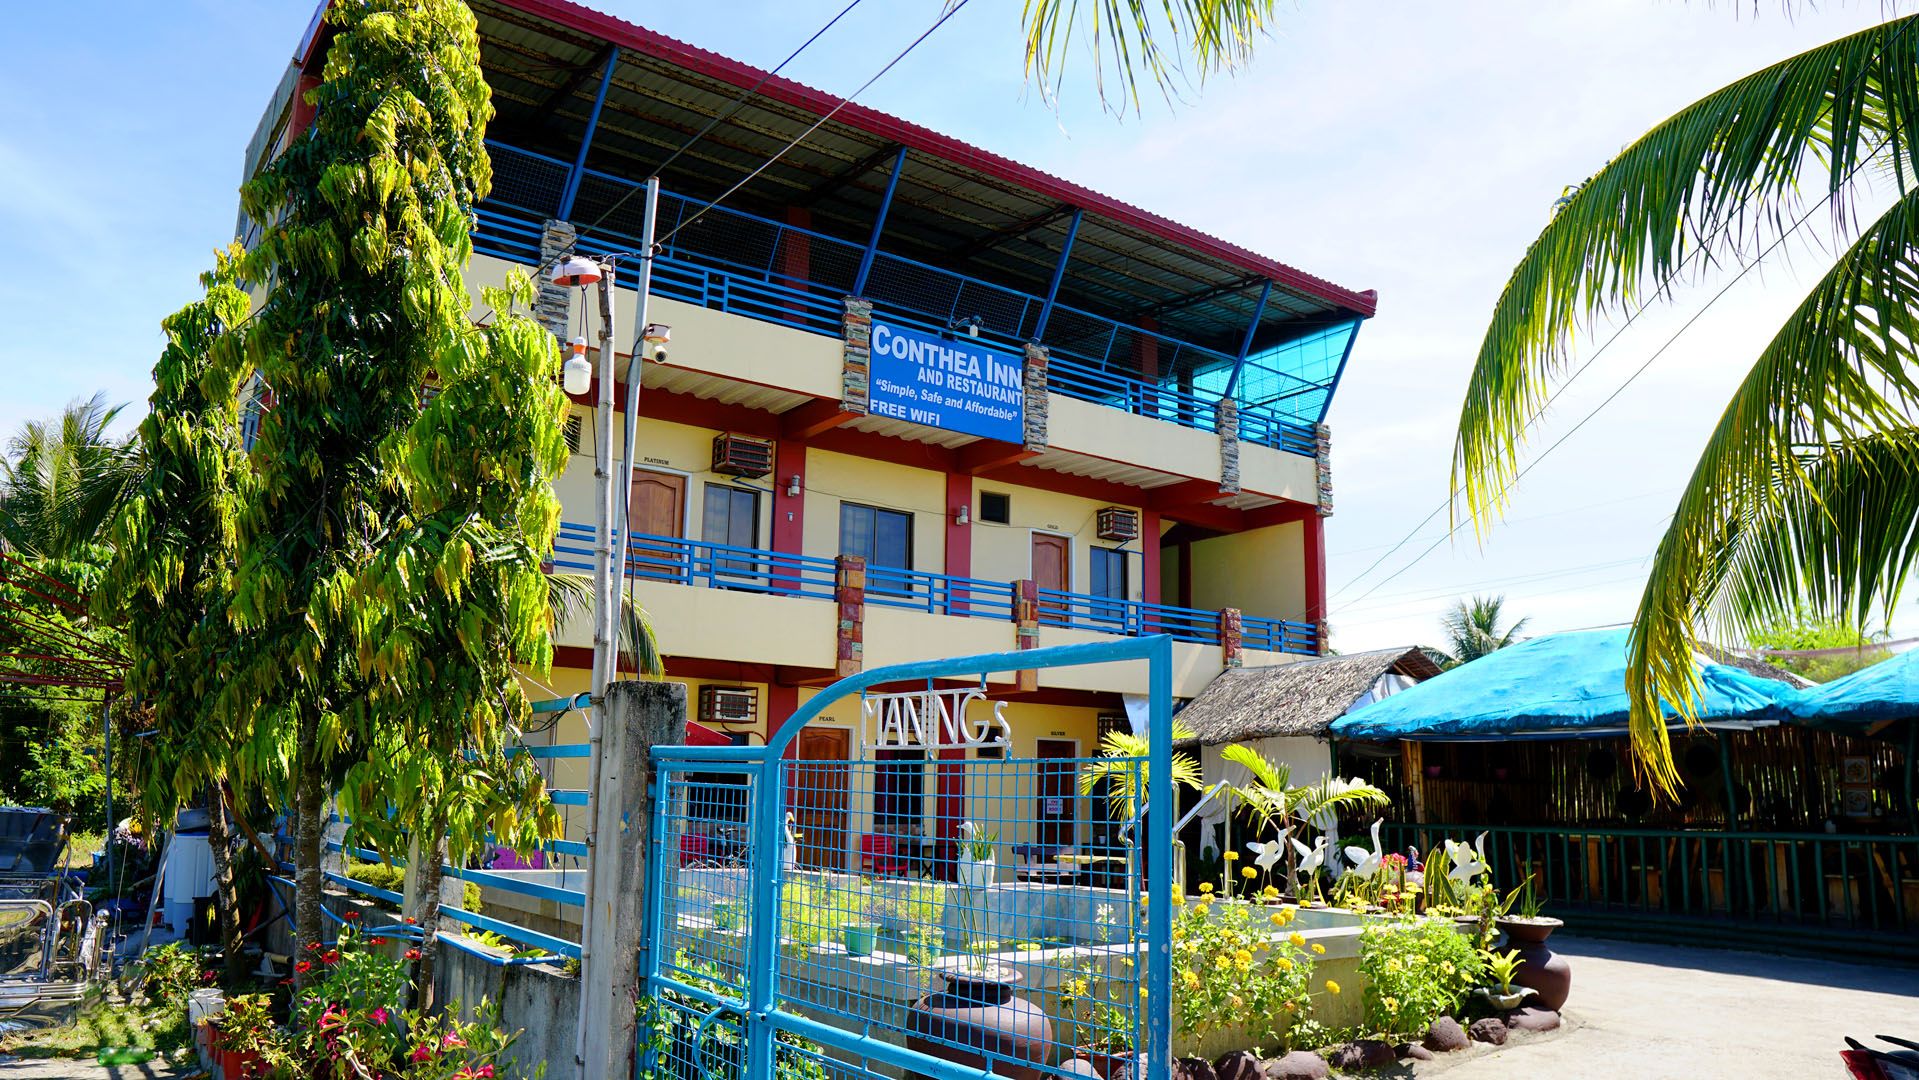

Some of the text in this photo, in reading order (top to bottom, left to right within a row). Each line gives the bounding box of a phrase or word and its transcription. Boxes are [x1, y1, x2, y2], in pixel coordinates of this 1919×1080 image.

[872, 325, 1022, 390] CONTHEA INN
[875, 378, 1018, 421] “Simple, Safe and Affordable”
[917, 367, 1022, 406] AND RESTAURANT
[870, 400, 940, 426] FREE WIFI
[643, 456, 670, 466] PLATINUM
